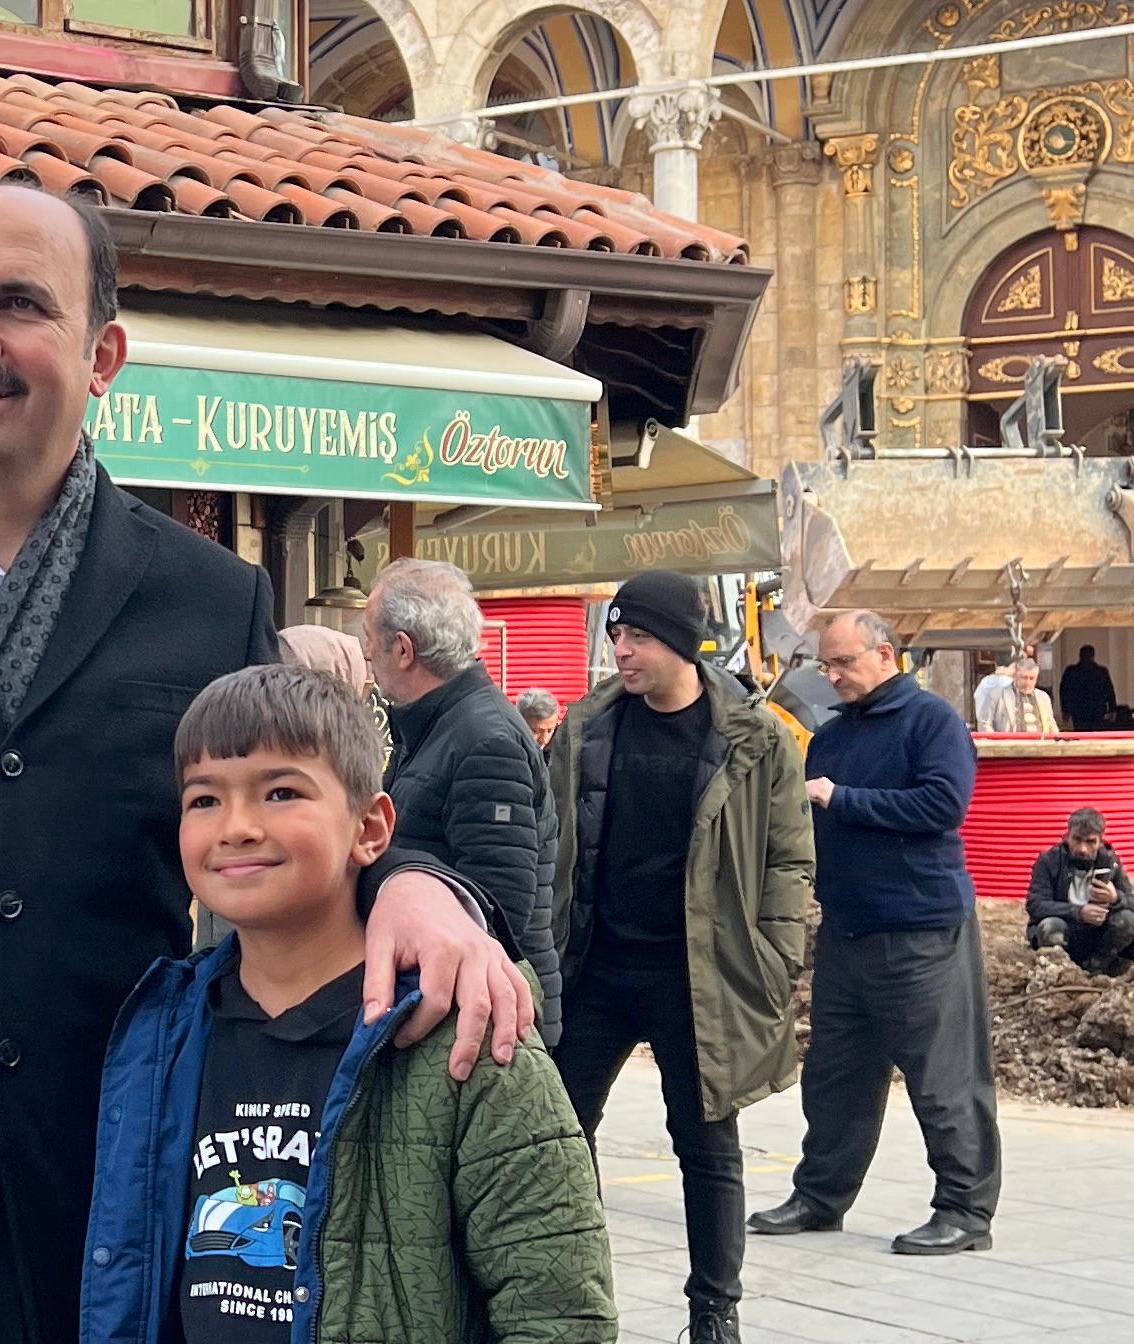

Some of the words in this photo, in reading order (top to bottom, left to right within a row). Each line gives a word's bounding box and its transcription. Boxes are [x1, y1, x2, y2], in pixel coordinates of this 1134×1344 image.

[85, 391, 163, 444] ATA
[439, 409, 569, 479] Öztorun
[220, 1299, 265, 1319] SINCE
[275, 1288, 294, 1305] CH
